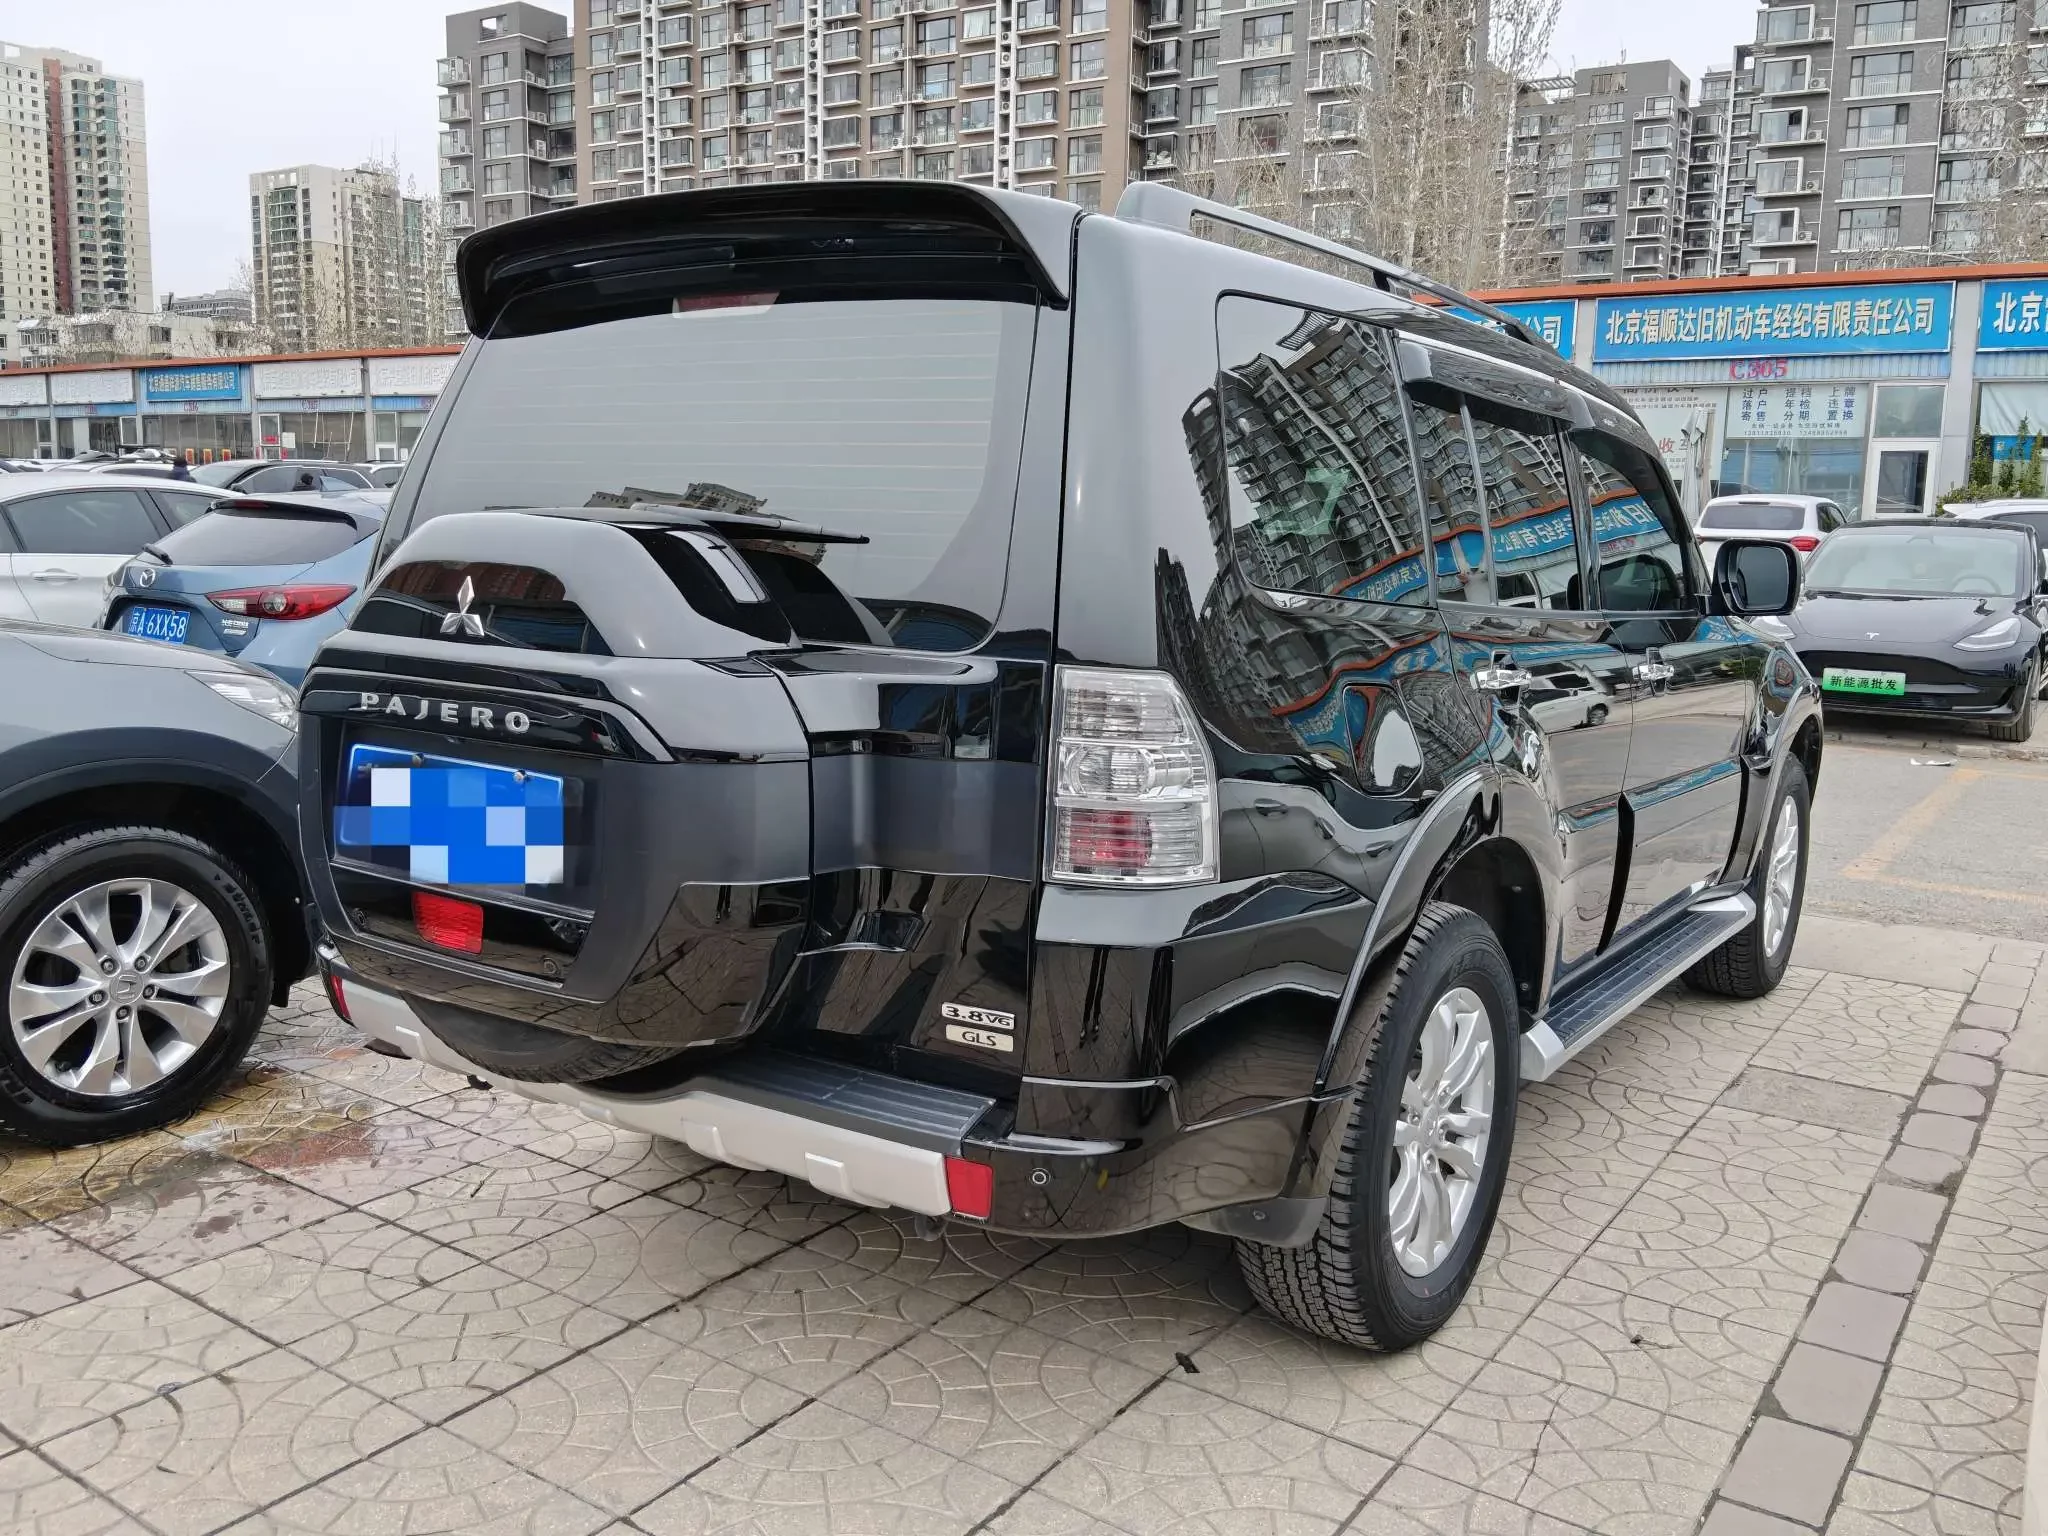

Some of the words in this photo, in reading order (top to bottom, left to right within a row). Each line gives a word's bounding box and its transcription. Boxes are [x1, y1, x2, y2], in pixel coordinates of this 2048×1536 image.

[1993, 290, 2048, 334] 北京
[1605, 298, 1935, 345] 北京福顺达旧机动车经纪有限责任公司
[1729, 358, 1789, 380] C305
[1742, 386, 1768, 399] 过户
[1828, 386, 1856, 398] 上牌
[1742, 399, 1767, 410] 落户
[1784, 399, 1810, 410] 年检
[1827, 398, 1854, 409] 违章
[1741, 411, 1766, 422] 寄售
[1783, 410, 1809, 421] 分期
[1827, 409, 1854, 421] 置换
[1830, 674, 1897, 691] 新能源批发
[360, 692, 530, 734] PAJERO
[961, 1031, 997, 1047] GLS
